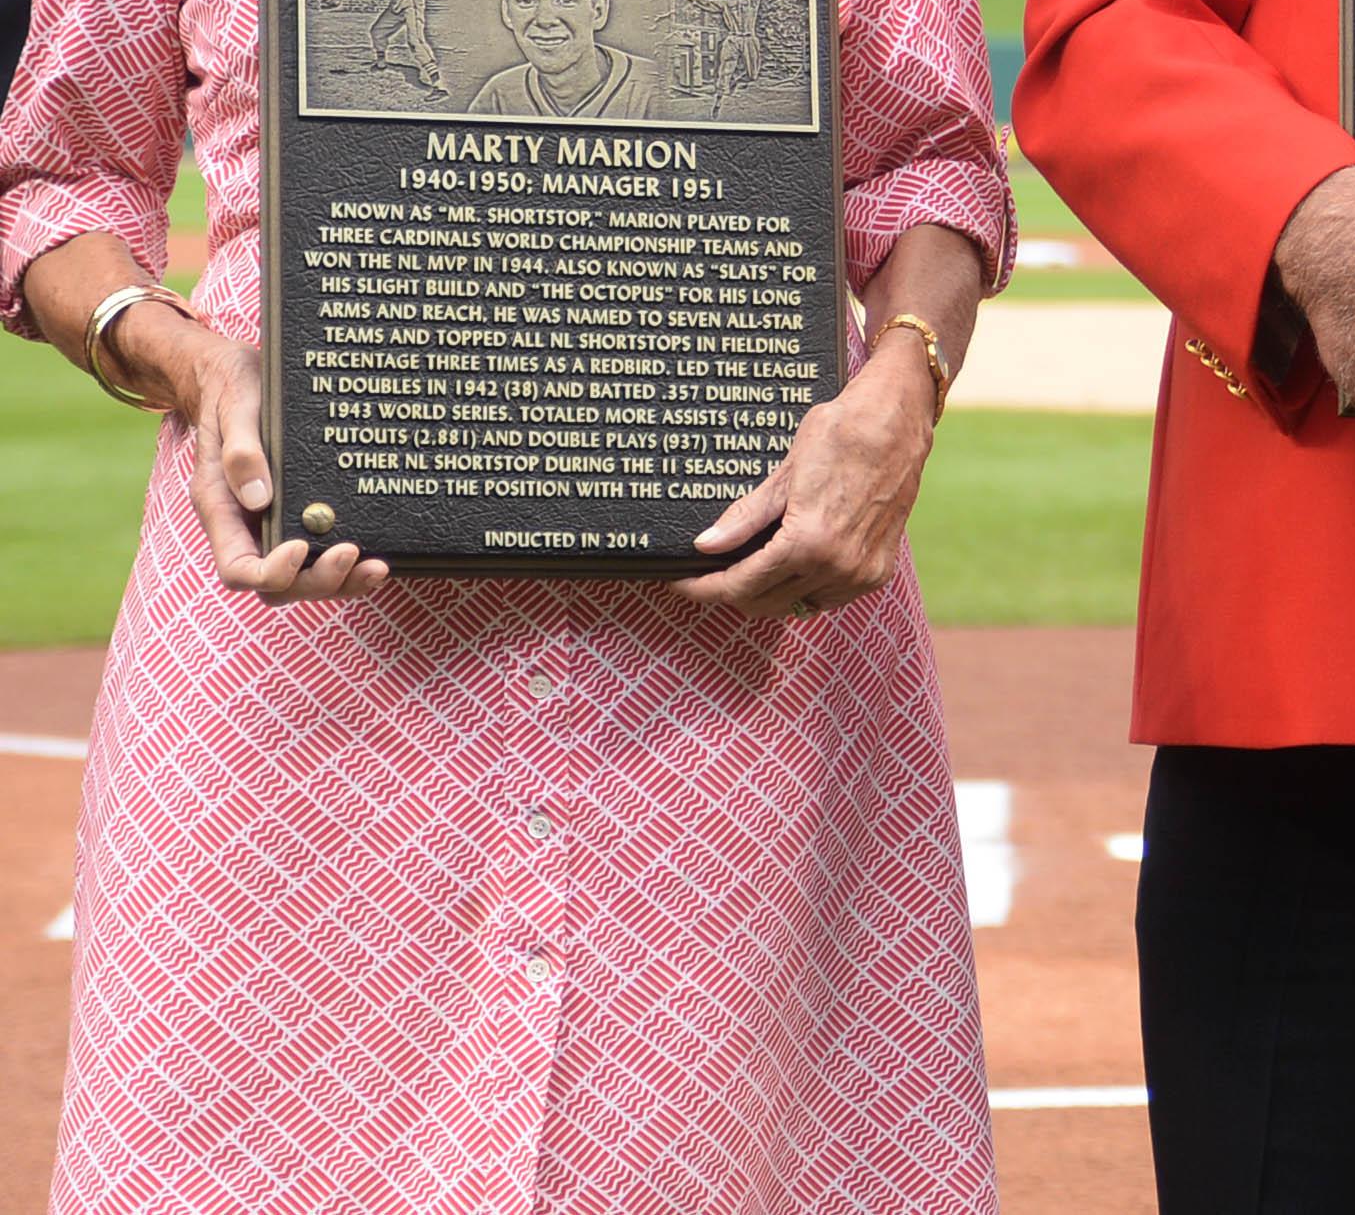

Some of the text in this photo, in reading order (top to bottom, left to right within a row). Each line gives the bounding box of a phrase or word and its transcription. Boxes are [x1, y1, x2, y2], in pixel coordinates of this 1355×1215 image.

[426, 131, 696, 169] MARTY MARION
[400, 167, 722, 199] 1940-1950; MANAGER 1951
[317, 225, 803, 257] THREE CARDINALS WORLD CHAMPIONSHIP TEAMS AND
[319, 300, 803, 330] ARMS AND REACH, HE WAS NAMED TO SEVEN ALL-STAR
[323, 325, 800, 354] TEAMS AND TOPPED ALL NL SHORTSTOPS IN FIELDING
[305, 349, 819, 378] PERCENTAGE THREE TIMES AS A REDBIRD. LED THE LEAGUE
[484, 530, 649, 548] INDUCTED IN 2014
